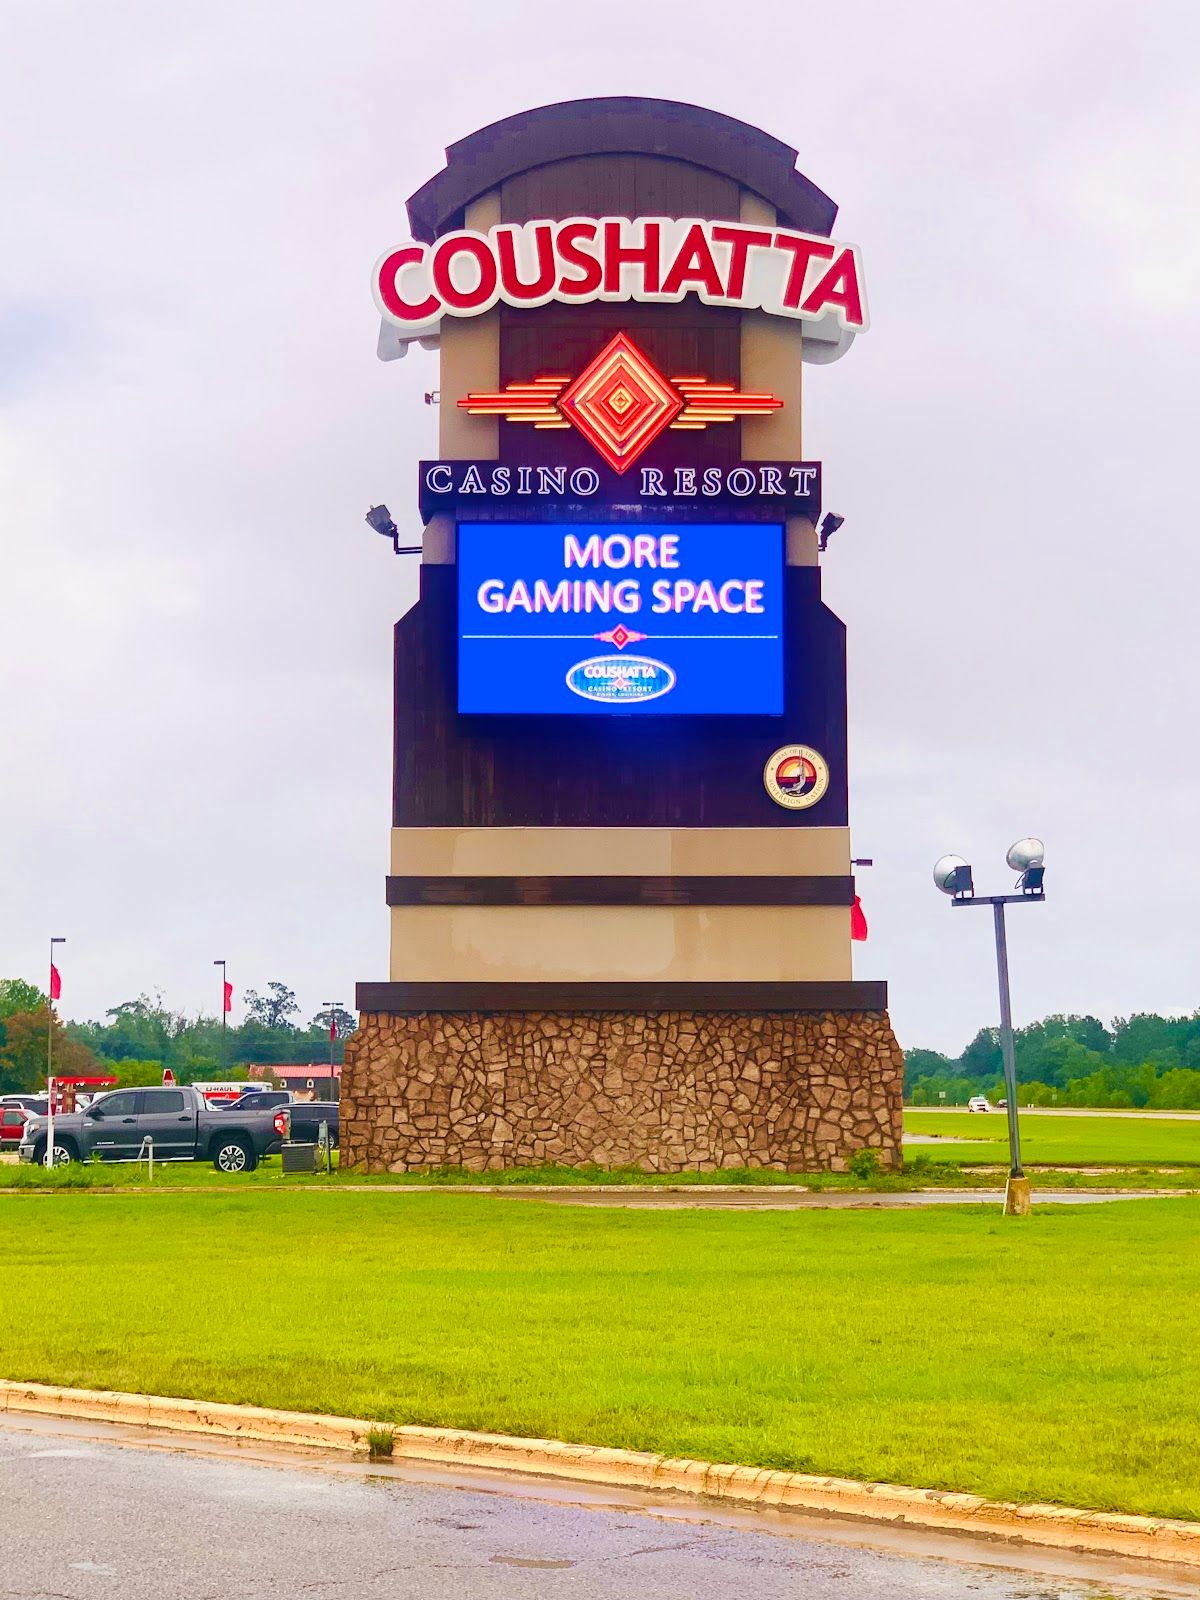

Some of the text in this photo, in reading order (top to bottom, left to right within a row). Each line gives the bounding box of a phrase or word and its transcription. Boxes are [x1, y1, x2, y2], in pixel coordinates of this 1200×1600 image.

[378, 223, 864, 326] COUSHATTA
[426, 465, 816, 496] CASINO RESORT
[564, 533, 680, 569] MORE
[477, 579, 765, 613] GAMING SPACE
[583, 665, 656, 679] COUSHATTA
